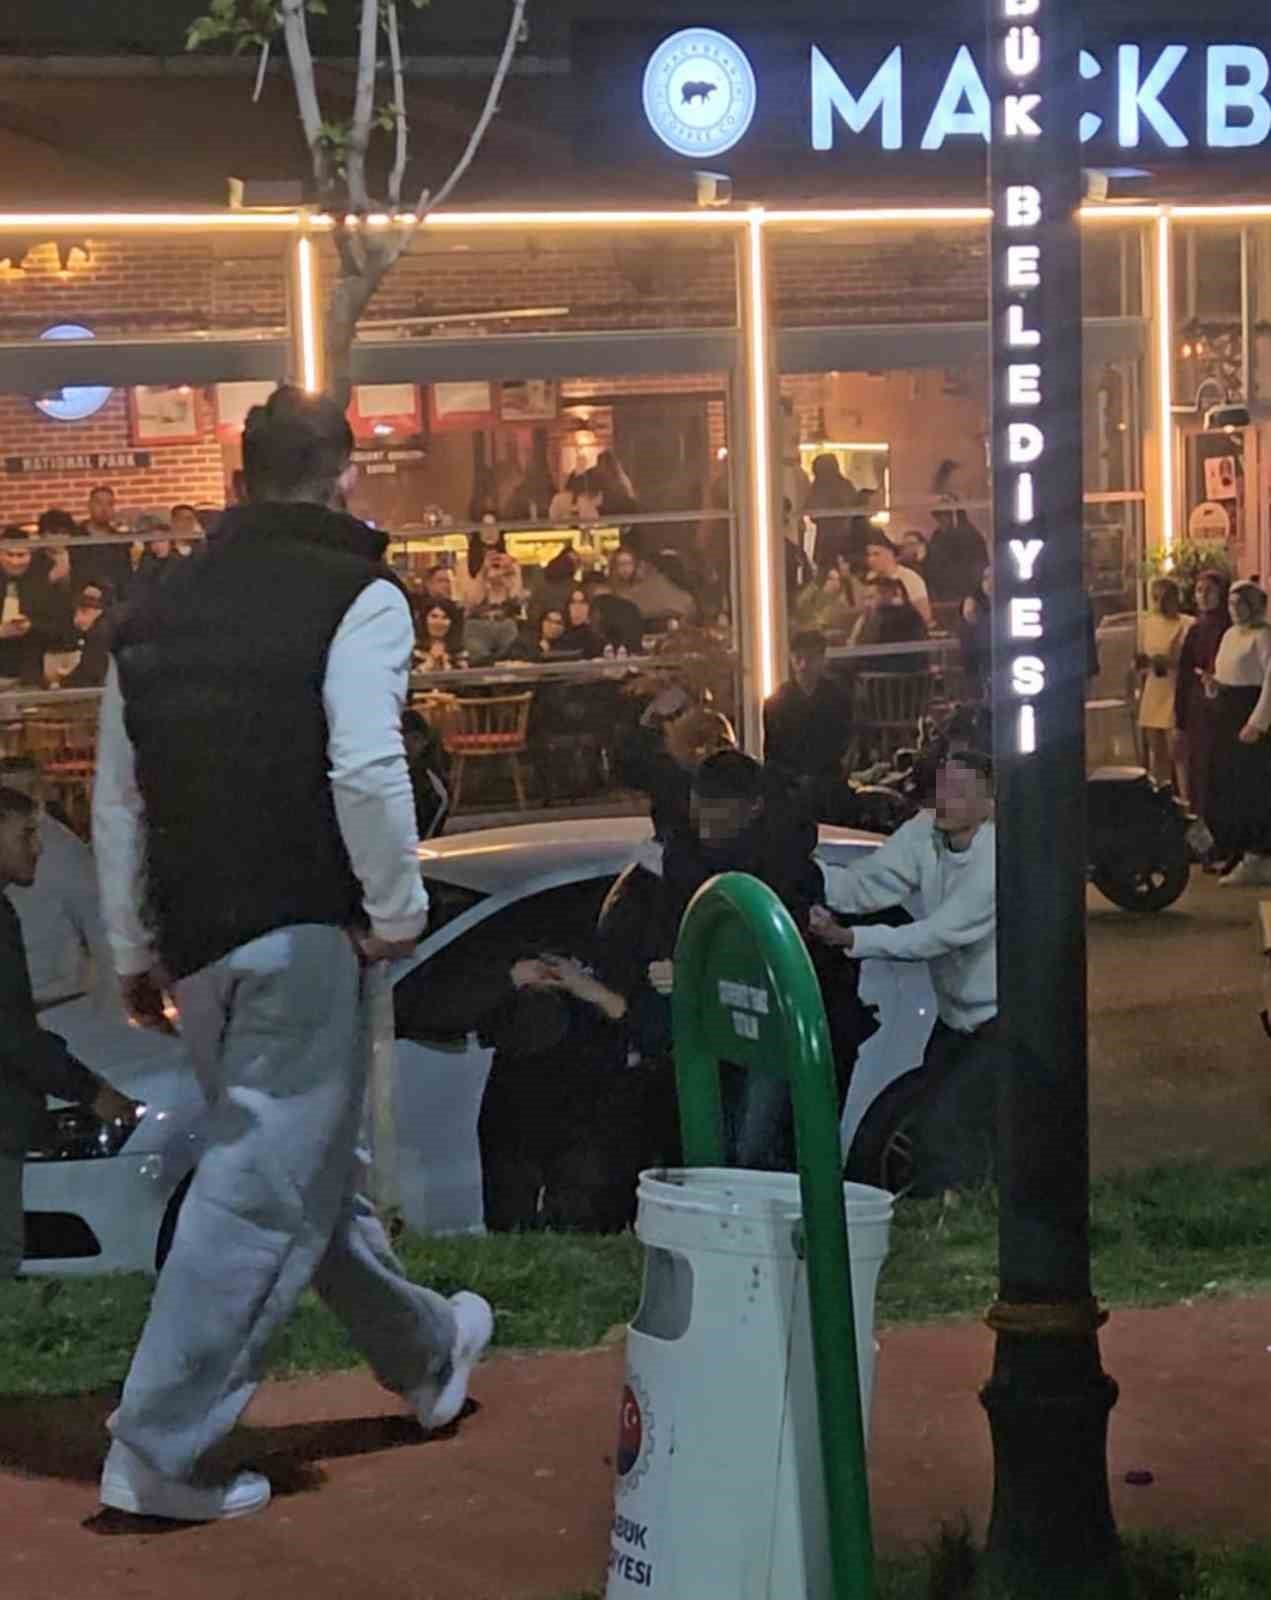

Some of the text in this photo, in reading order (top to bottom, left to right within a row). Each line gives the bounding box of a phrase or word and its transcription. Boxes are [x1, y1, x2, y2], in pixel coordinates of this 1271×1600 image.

[811, 44, 1271, 150] MAKB
[98, 452, 135, 468] PARK
[1006, 185, 1045, 754] BELEDİYESİ
